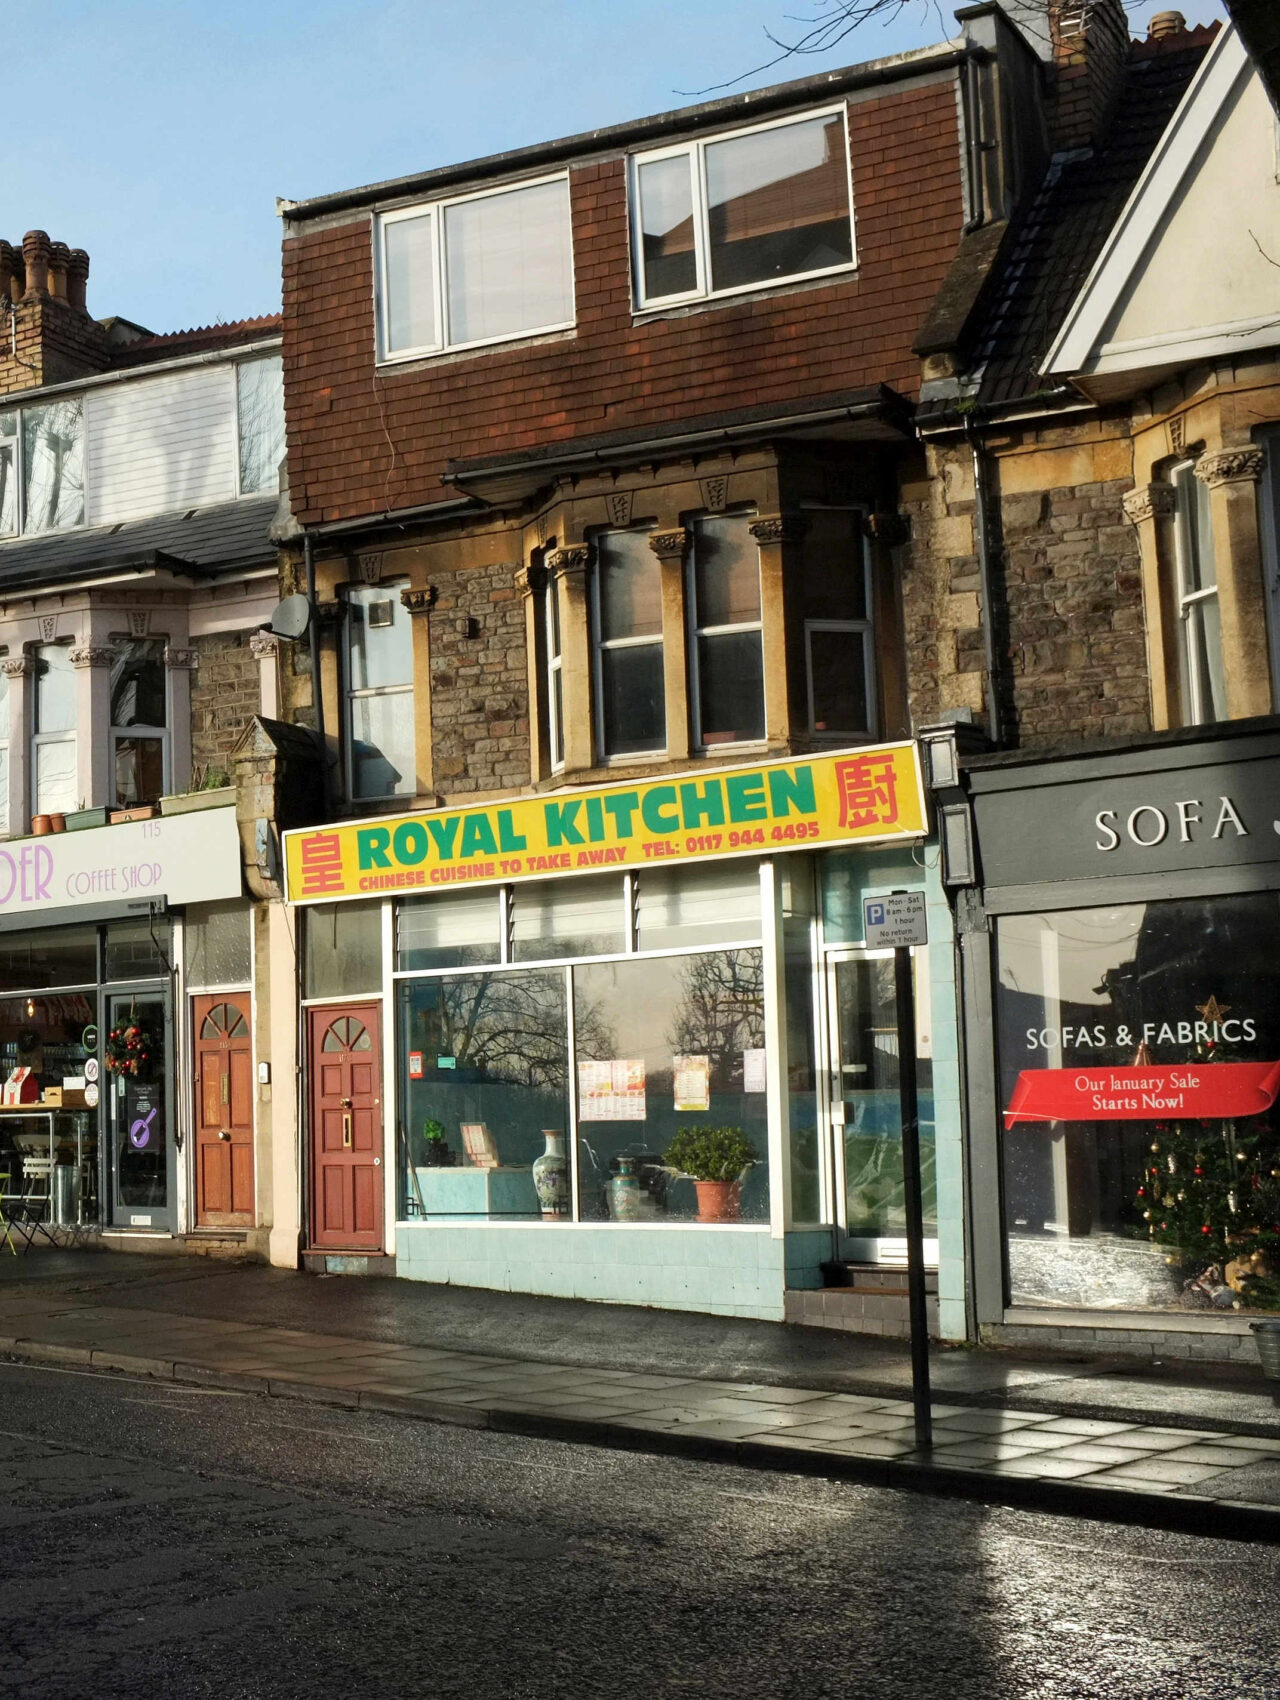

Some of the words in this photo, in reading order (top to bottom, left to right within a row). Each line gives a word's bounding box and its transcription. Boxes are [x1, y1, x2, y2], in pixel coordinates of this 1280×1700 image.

[142, 821, 161, 839] 115
[357, 809, 527, 871] ROYAL
[544, 765, 817, 847] KITCHEN
[1095, 796, 1249, 851] SOFA
[301, 833, 345, 895] 皇
[359, 871, 425, 891] CHINESE
[430, 862, 495, 882] CUISINE
[500, 859, 521, 874] TO
[526, 853, 571, 871] TAKE
[577, 846, 627, 867] AWAY
[642, 841, 680, 858] TEL:
[686, 834, 722, 853] 0117
[729, 828, 765, 846] 944
[771, 821, 819, 842] 4495
[66, 868, 118, 898] COFFEE
[122, 862, 162, 893] SHOP
[871, 906, 882, 924] P
[908, 896, 920, 904] Sat
[1026, 1025, 1106, 1050] SOFAS
[1115, 1024, 1133, 1046] &
[1143, 1018, 1257, 1045] FABRICS
[1075, 1075, 1104, 1092] Our
[1110, 1074, 1164, 1092] January
[1170, 1073, 1200, 1089] Sale
[1092, 1094, 1138, 1111] Starts
[1142, 1093, 1184, 1109] Now!
